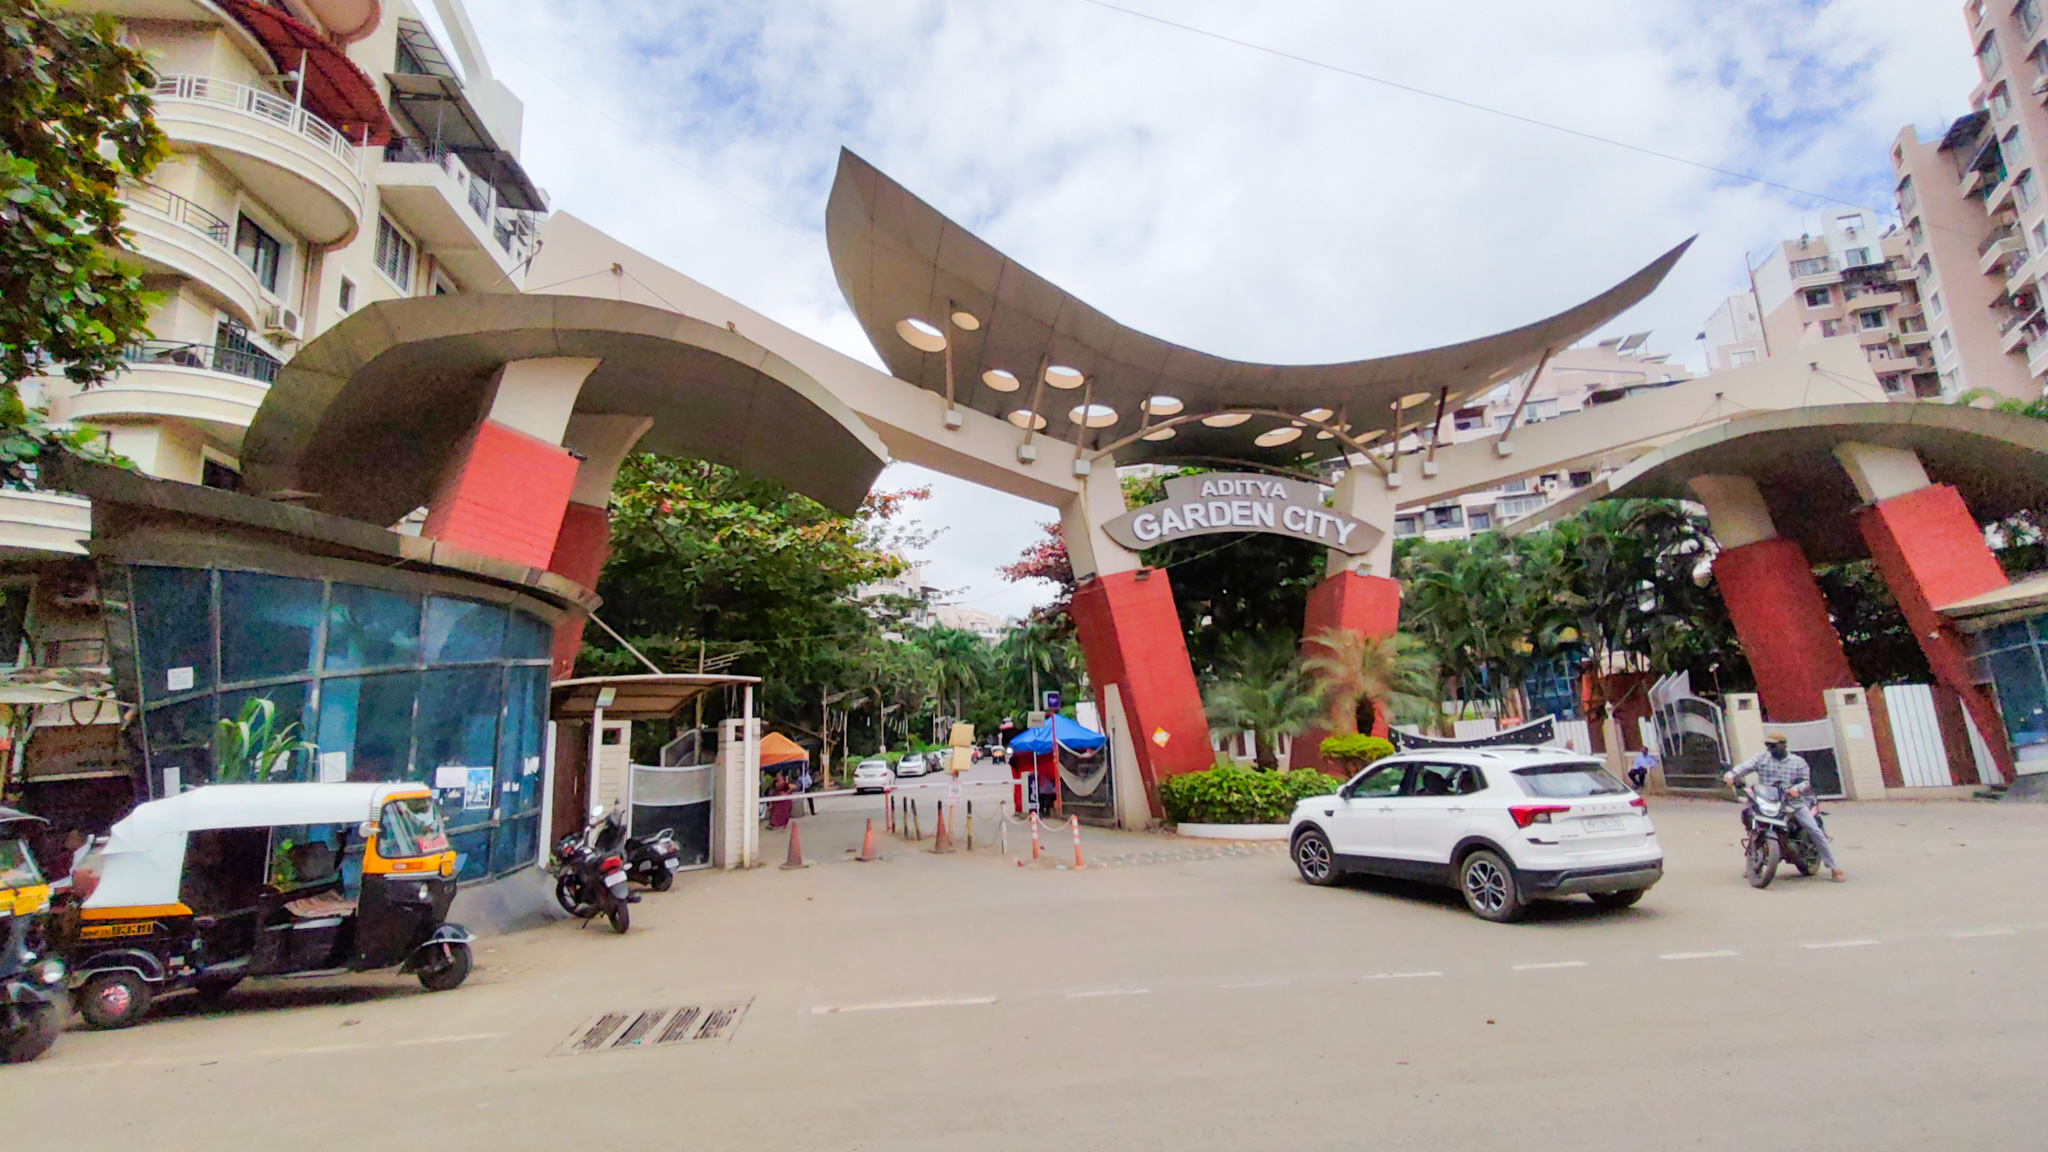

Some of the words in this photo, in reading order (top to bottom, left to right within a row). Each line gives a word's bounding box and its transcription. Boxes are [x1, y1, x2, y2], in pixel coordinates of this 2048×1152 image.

[1200, 479, 1287, 499] ADITYA
[1132, 500, 1275, 541] GARDEN
[1283, 505, 1357, 545] CITY
